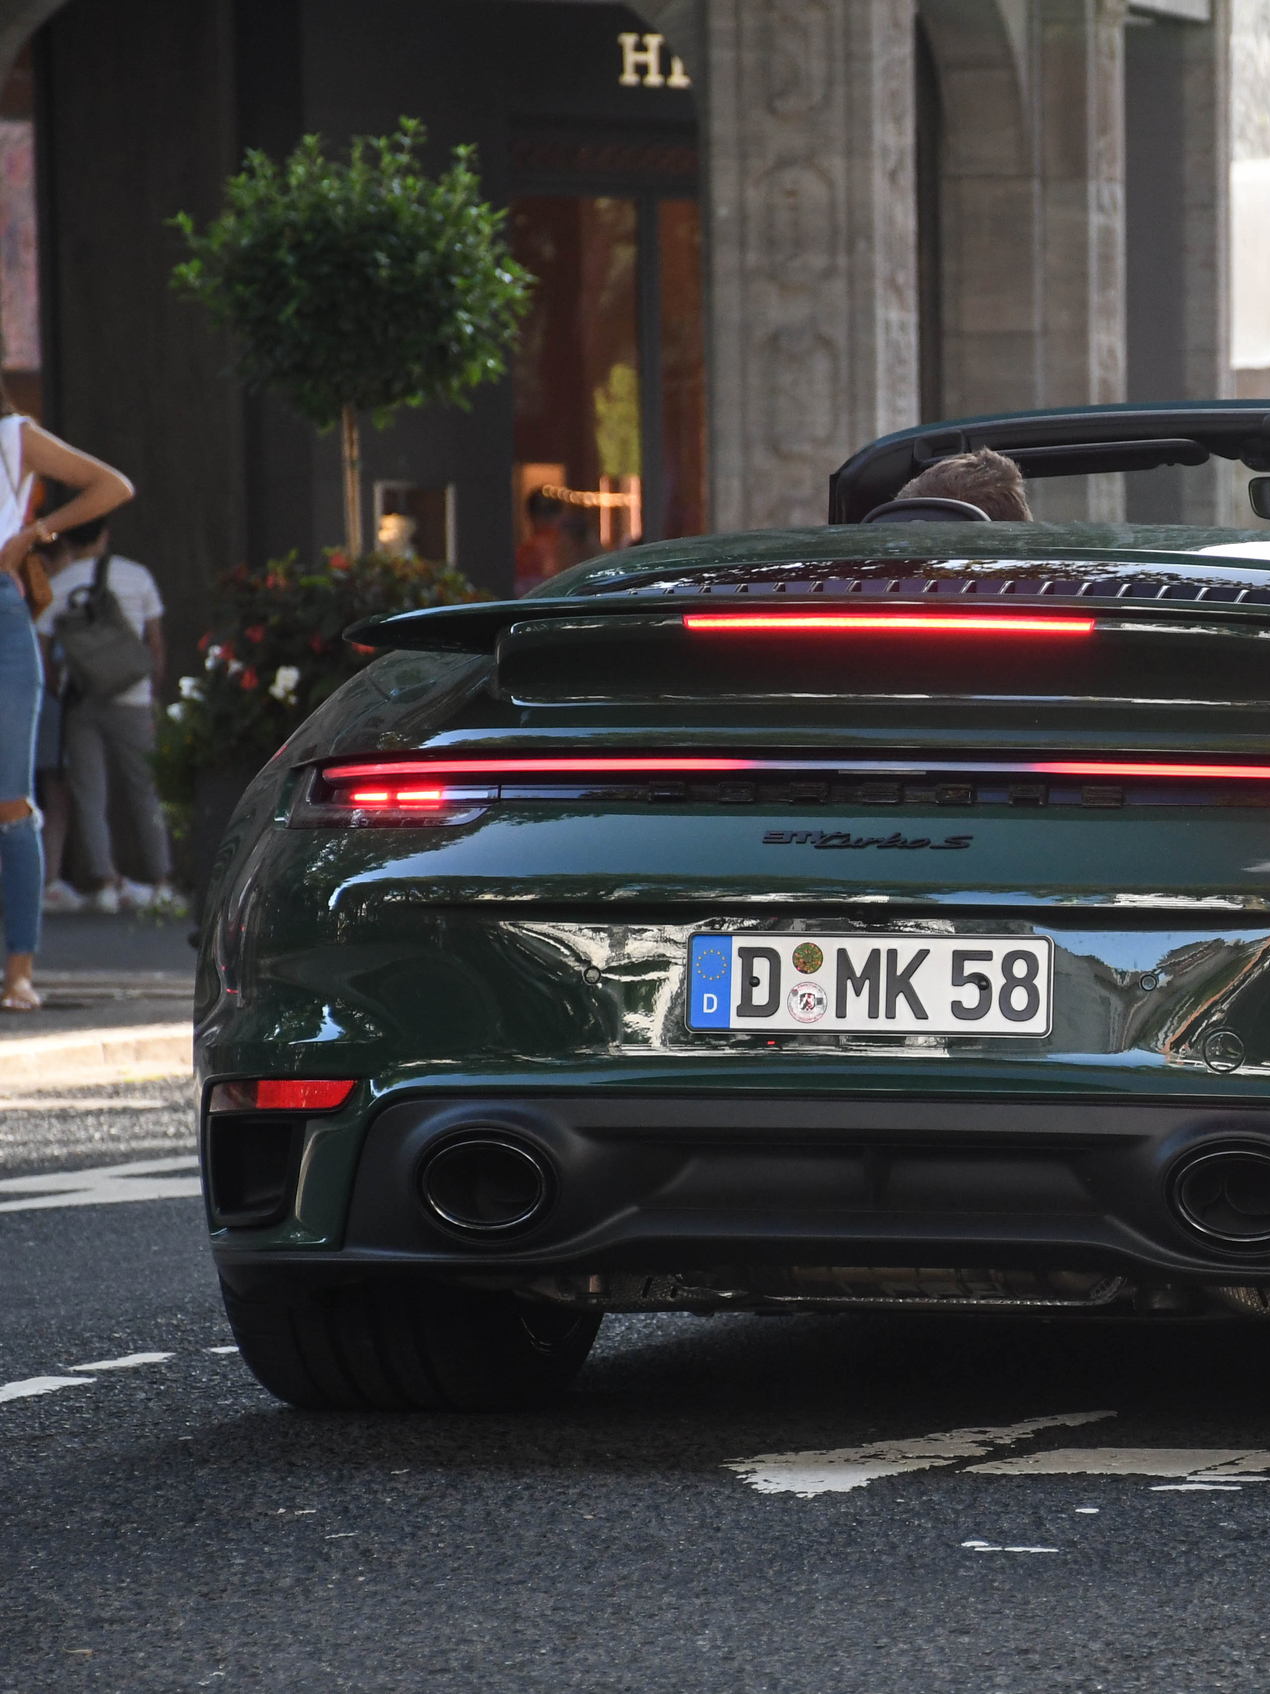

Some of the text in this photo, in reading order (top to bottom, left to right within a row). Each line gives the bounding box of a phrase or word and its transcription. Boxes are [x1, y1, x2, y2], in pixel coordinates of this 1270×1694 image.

[648, 781, 1125, 807] PORSCHE
[929, 835, 974, 850] S
[736, 946, 781, 1018] D
[835, 948, 931, 1020] MK
[950, 950, 1040, 1021] 58
[703, 993, 718, 1014] D
